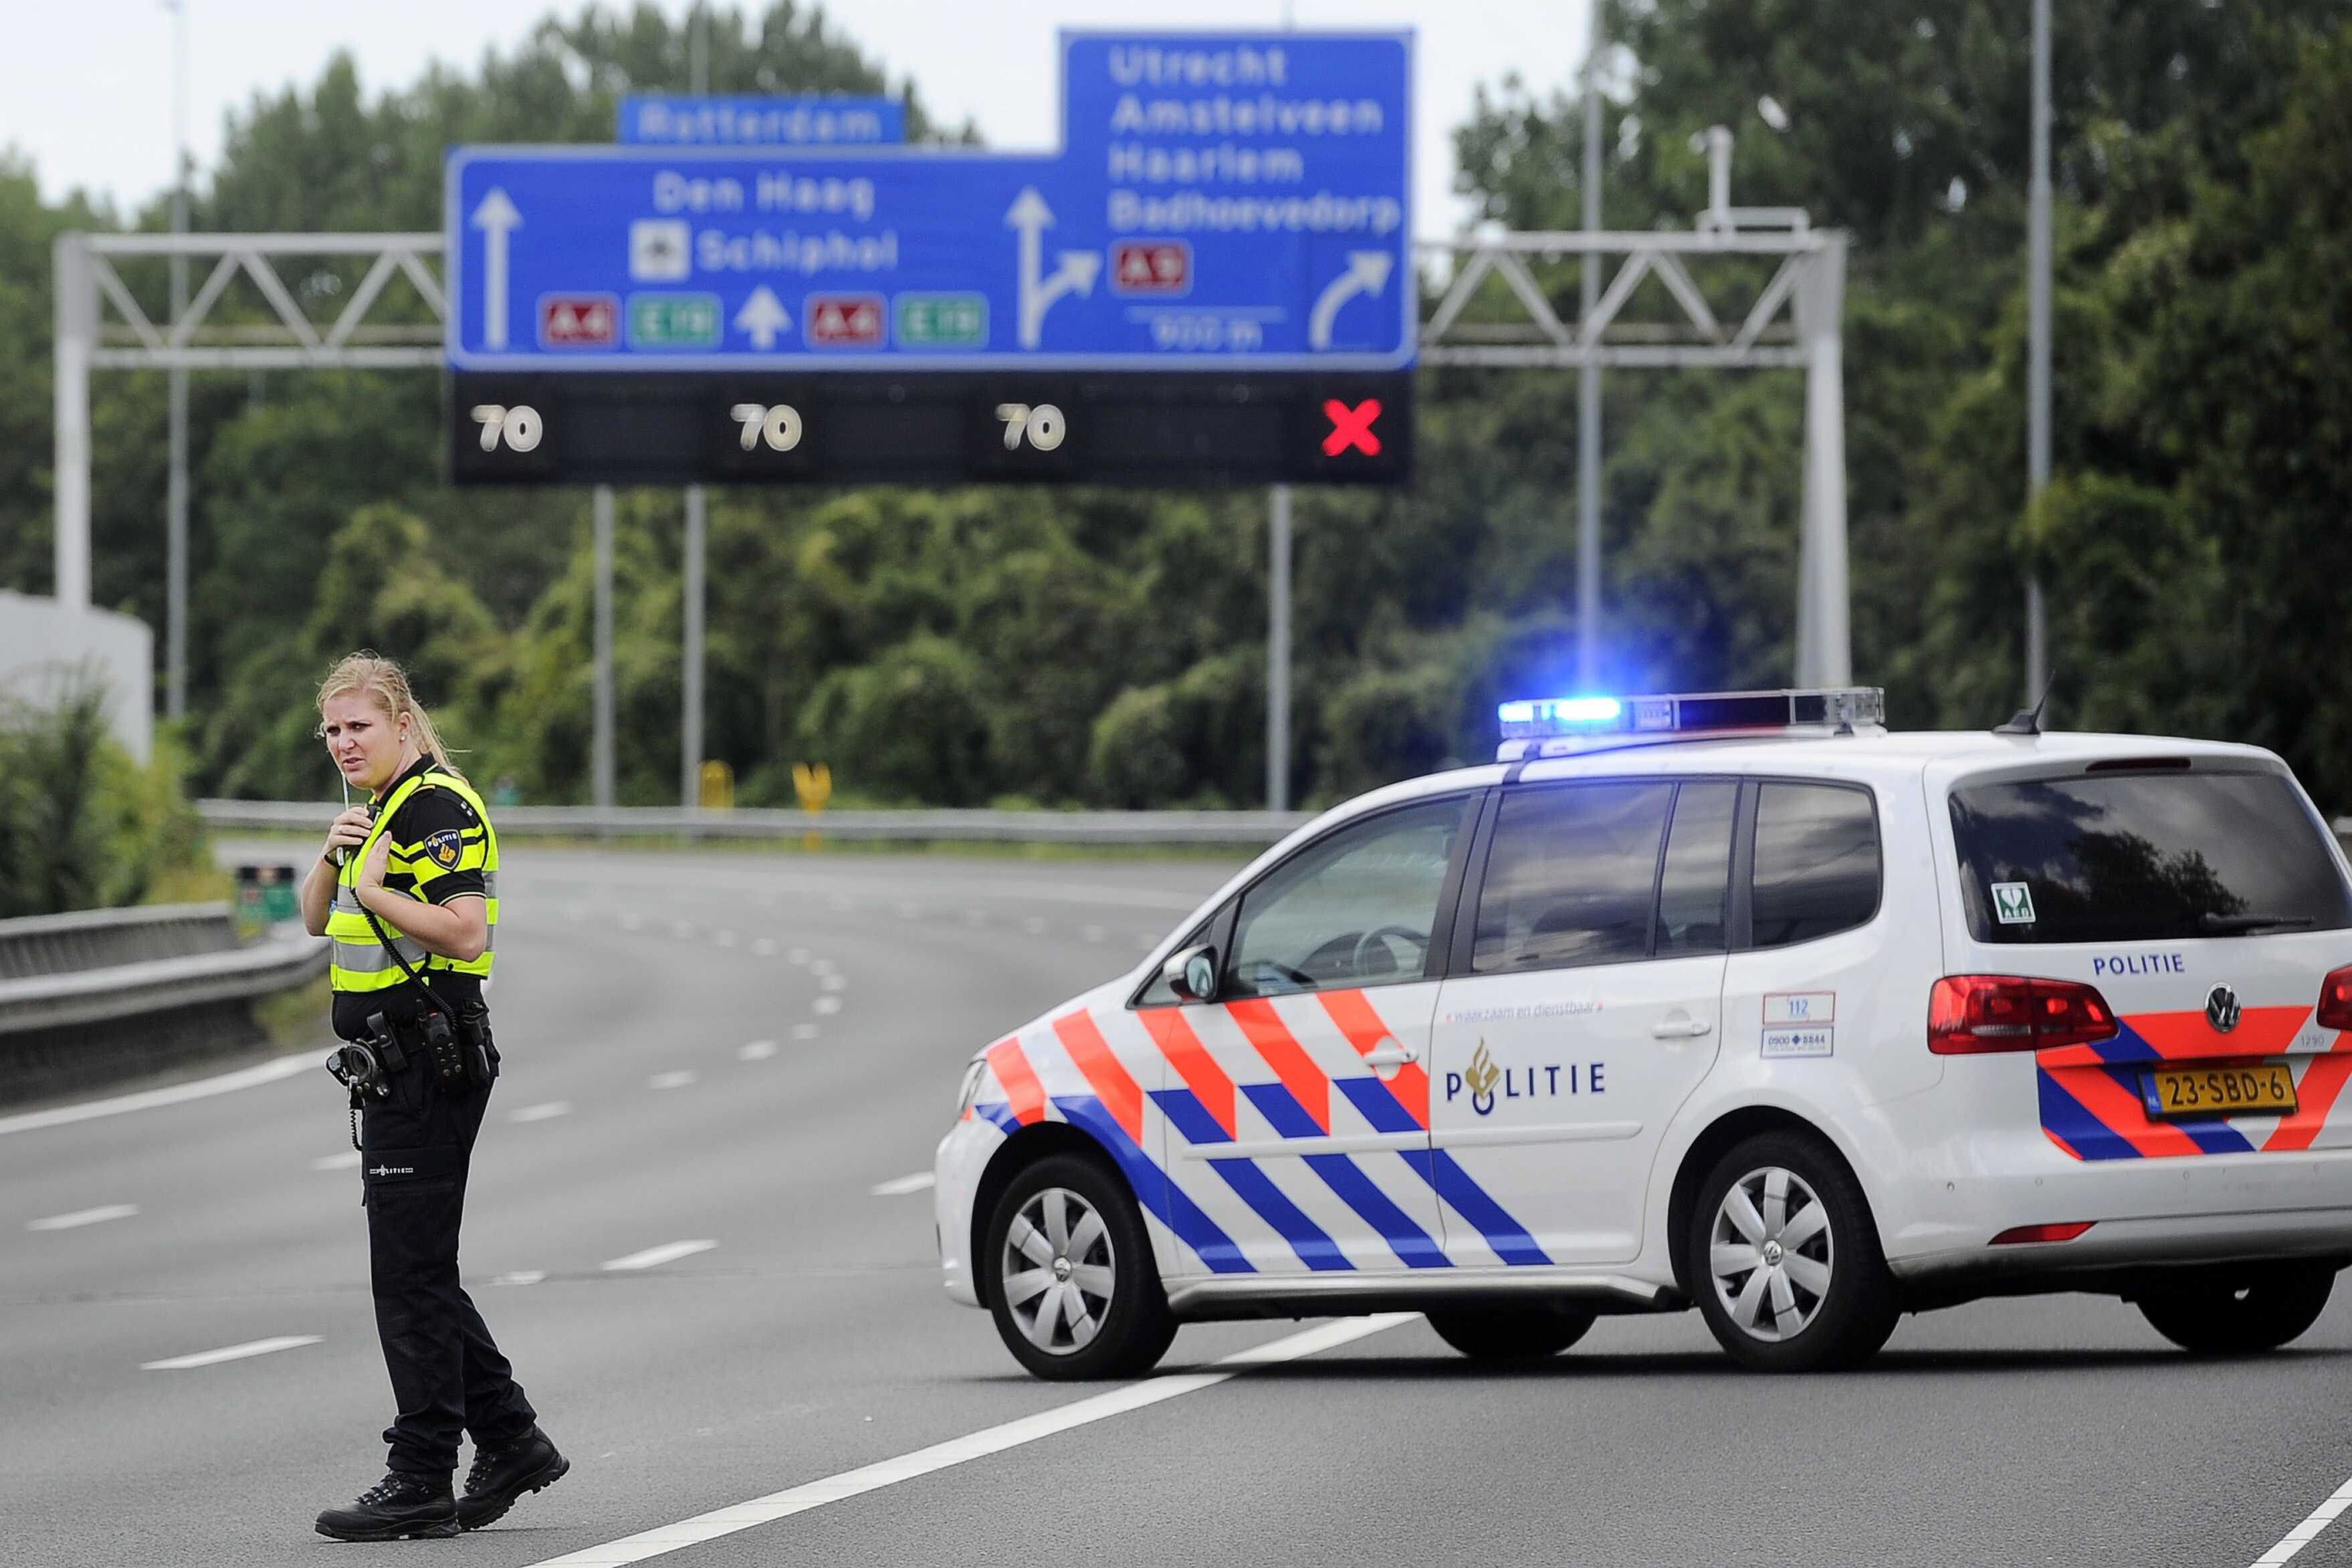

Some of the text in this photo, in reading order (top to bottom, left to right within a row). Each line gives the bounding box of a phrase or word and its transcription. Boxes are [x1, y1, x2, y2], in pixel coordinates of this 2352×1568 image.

[1109, 45, 1288, 86] Utrecht
[639, 104, 881, 140] Rotterdam
[1111, 94, 1383, 134] Amstelveen
[1107, 141, 1303, 184] Haarlem
[653, 170, 875, 222] Den Haag
[1107, 189, 1401, 235] Badhoevedorp
[696, 229, 898, 277] Schiphol
[1117, 245, 1185, 286] A9
[548, 302, 610, 340] A4
[814, 302, 879, 340] A4
[471, 404, 542, 452] 70
[730, 403, 802, 451] 70
[994, 403, 1066, 451] 70
[2004, 907, 2030, 918] AED
[2093, 953, 2185, 976] POLITIE
[1517, 1008, 1531, 1018] en
[1534, 1000, 1595, 1018] dienstbaar
[1789, 999, 1808, 1016] 112
[1446, 1063, 1605, 1116] POLITIE
[2165, 1071, 2285, 1105] 23-SBD-6
